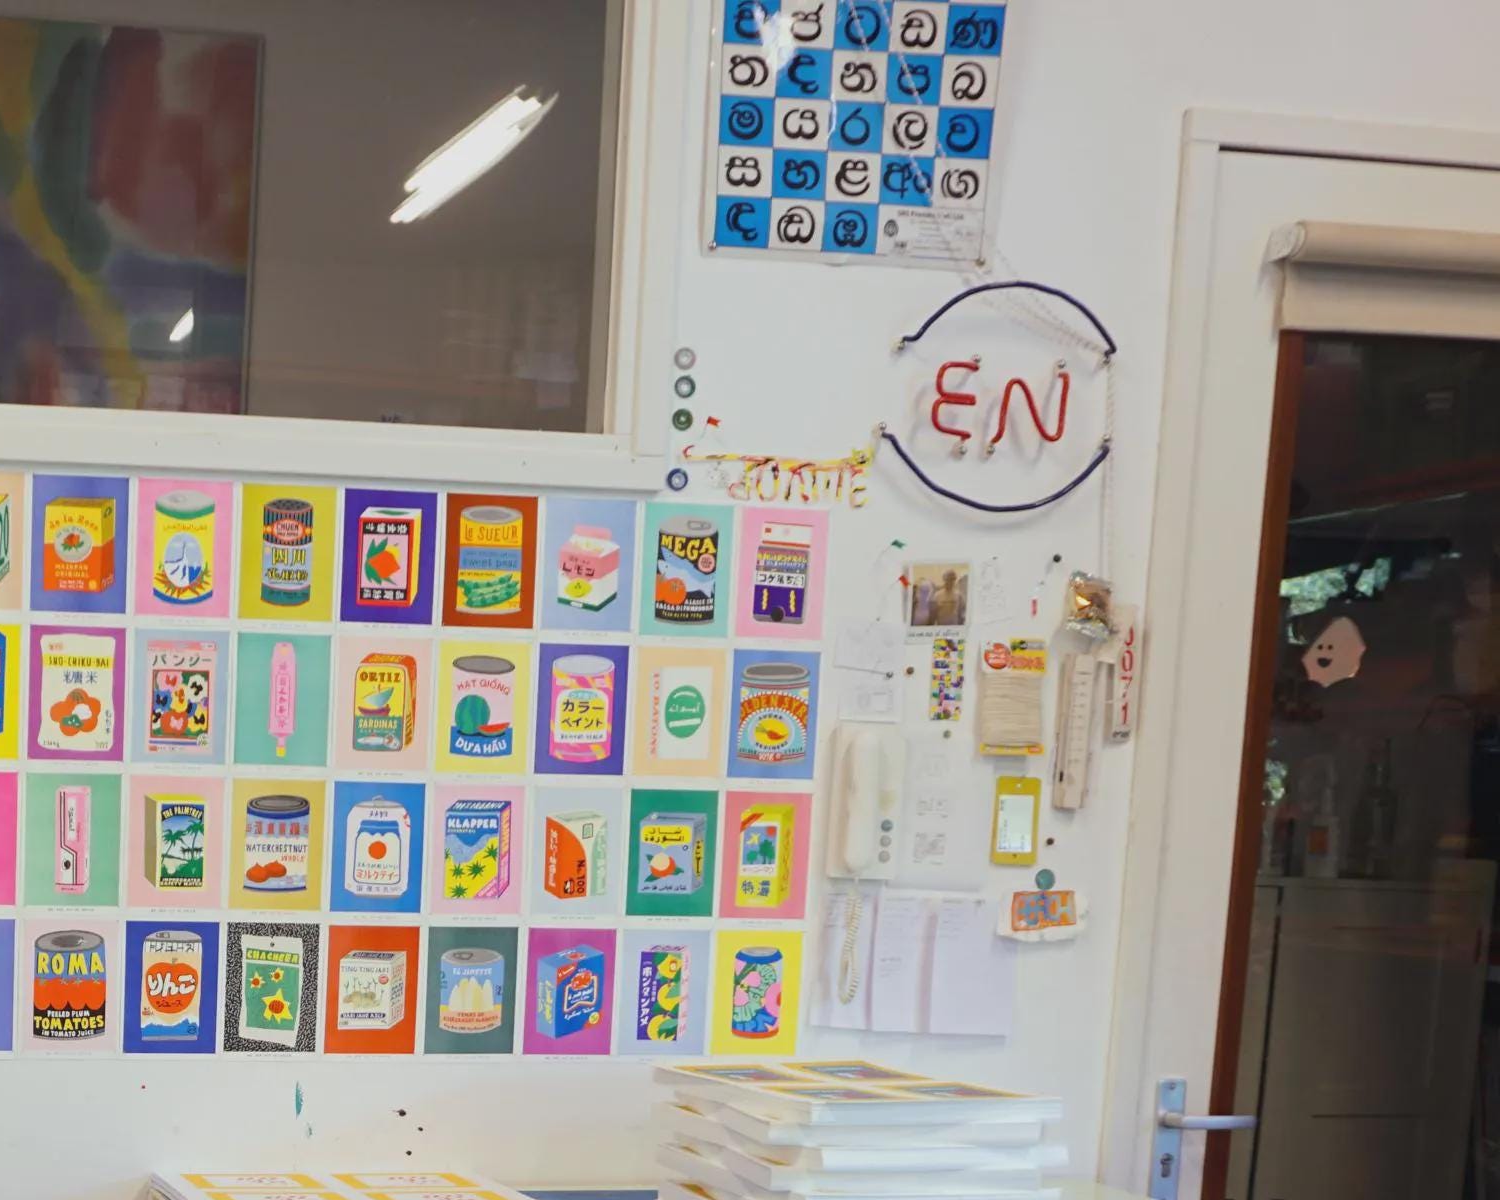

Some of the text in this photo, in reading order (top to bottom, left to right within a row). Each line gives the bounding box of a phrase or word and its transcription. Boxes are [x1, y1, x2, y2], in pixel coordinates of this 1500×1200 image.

[931, 360, 1069, 444] EN
[476, 525, 518, 542] SUEUR
[660, 534, 716, 561] MEGA
[359, 671, 402, 683] ORTIZ
[563, 698, 606, 714] カラー
[358, 718, 398, 730] SARDINAS
[447, 817, 499, 830] KLAPPER
[37, 952, 105, 976] ROMA
[147, 972, 198, 997] りんご
[640, 966, 651, 1027] ボンタンアメ
[47, 1009, 91, 1018] PEELED PLUM
[35, 1016, 105, 1031] TOMATOES
[51, 1030, 77, 1038] TOMATO
